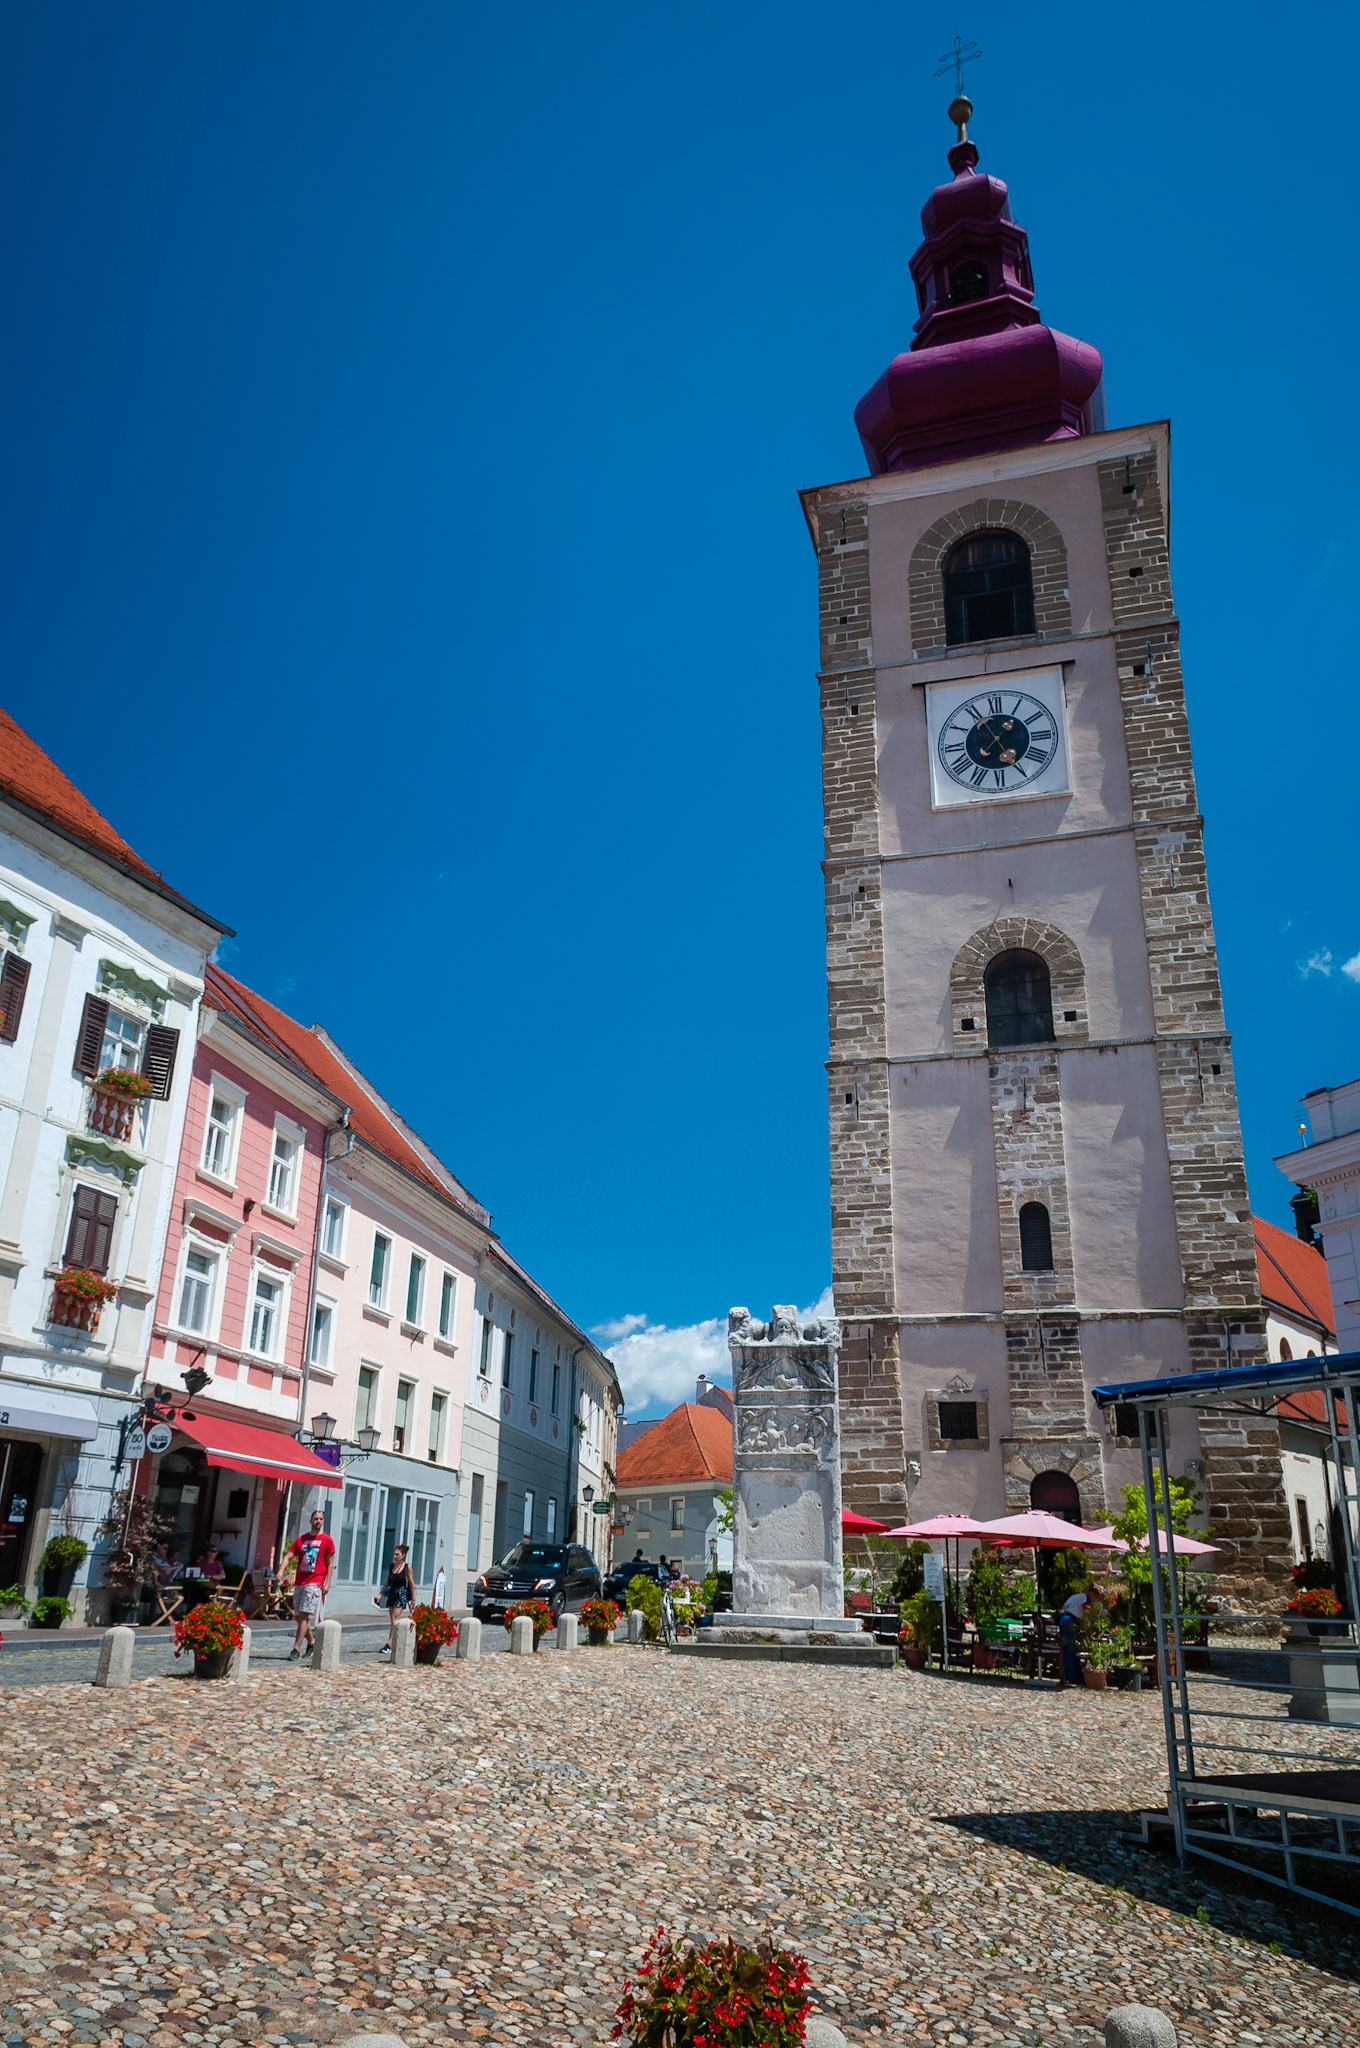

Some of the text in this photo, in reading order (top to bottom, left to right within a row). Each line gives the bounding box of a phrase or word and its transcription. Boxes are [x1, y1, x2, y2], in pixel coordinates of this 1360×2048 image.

[987, 696, 1003, 716] XII
[1023, 710, 1044, 726] II
[949, 722, 969, 735] X
[1030, 729, 1052, 742] III
[969, 766, 990, 787] VII
[993, 769, 1006, 788] VI
